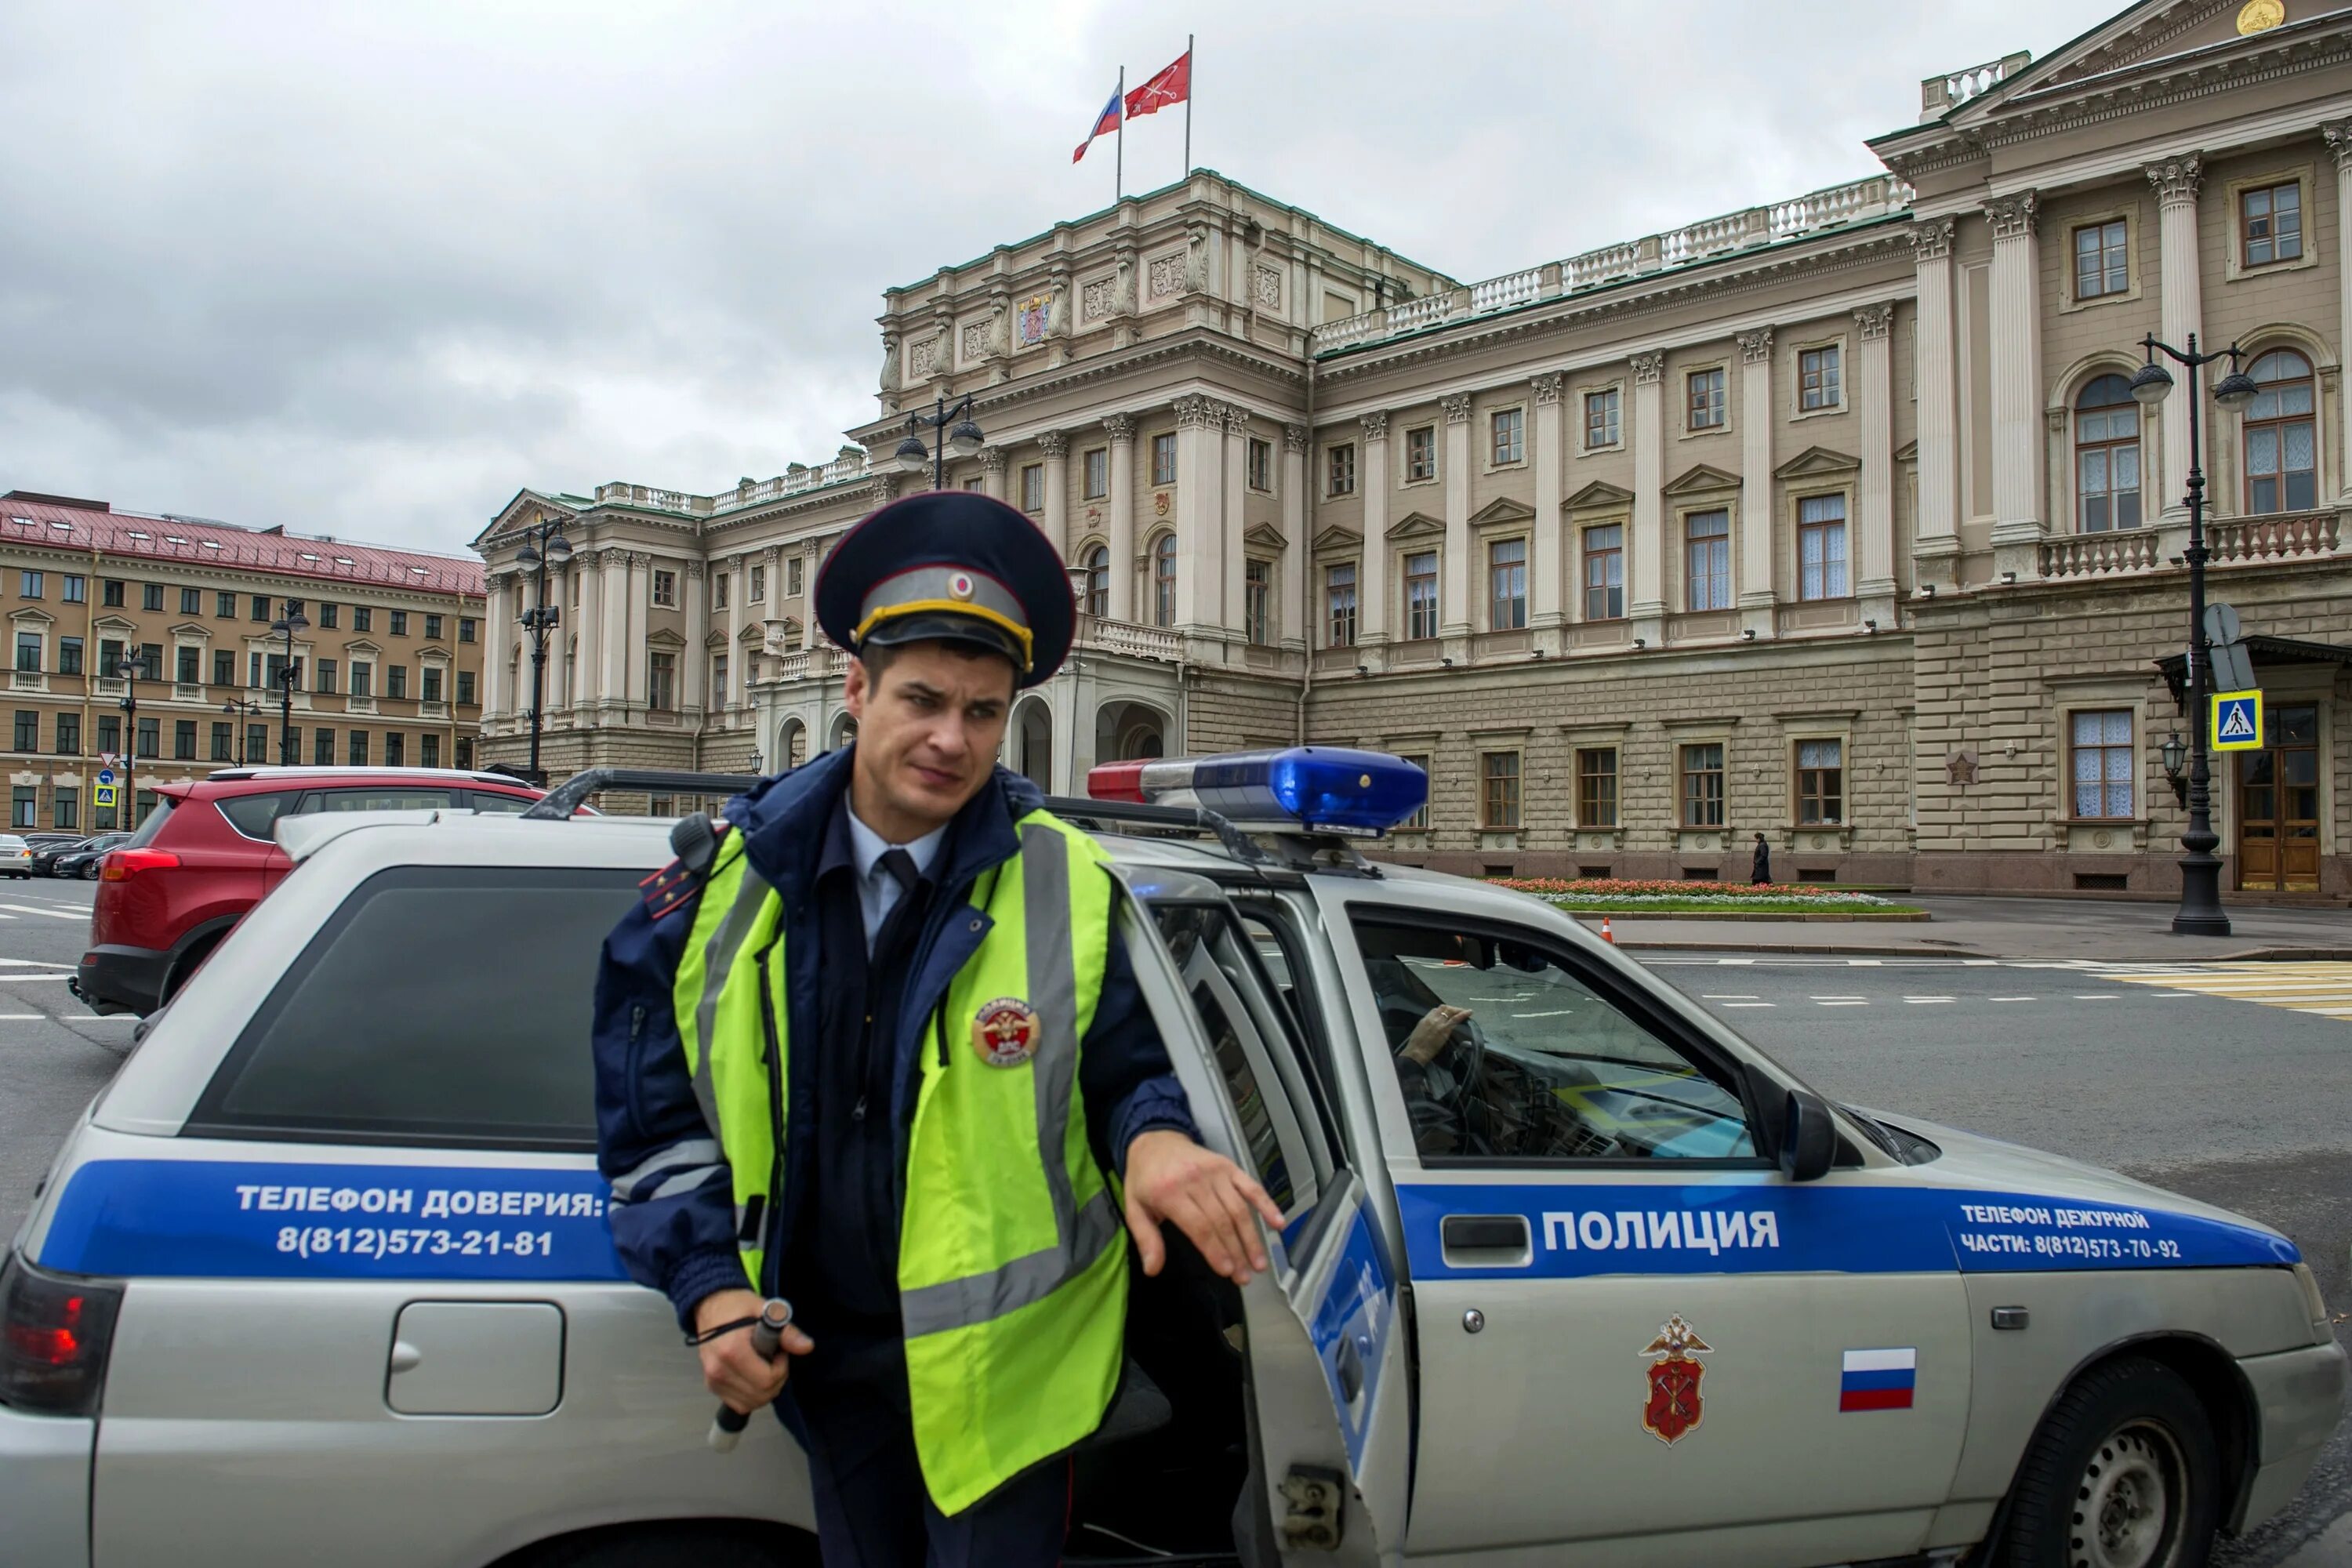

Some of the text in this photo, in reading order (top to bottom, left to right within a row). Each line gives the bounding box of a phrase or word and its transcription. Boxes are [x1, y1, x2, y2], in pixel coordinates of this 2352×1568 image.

[236, 1185, 603, 1219] ТЕЛЕФОН ДОВЕРИЯ:
[1961, 1205, 2150, 1229] ТЕЛЕФОН ДЕЖУРНОЙ
[276, 1227, 552, 1260] 8(812)573-21-81
[1542, 1210, 1780, 1256] ПОЛИЦИЯ
[1961, 1233, 2031, 1254] ЧАСТИ:
